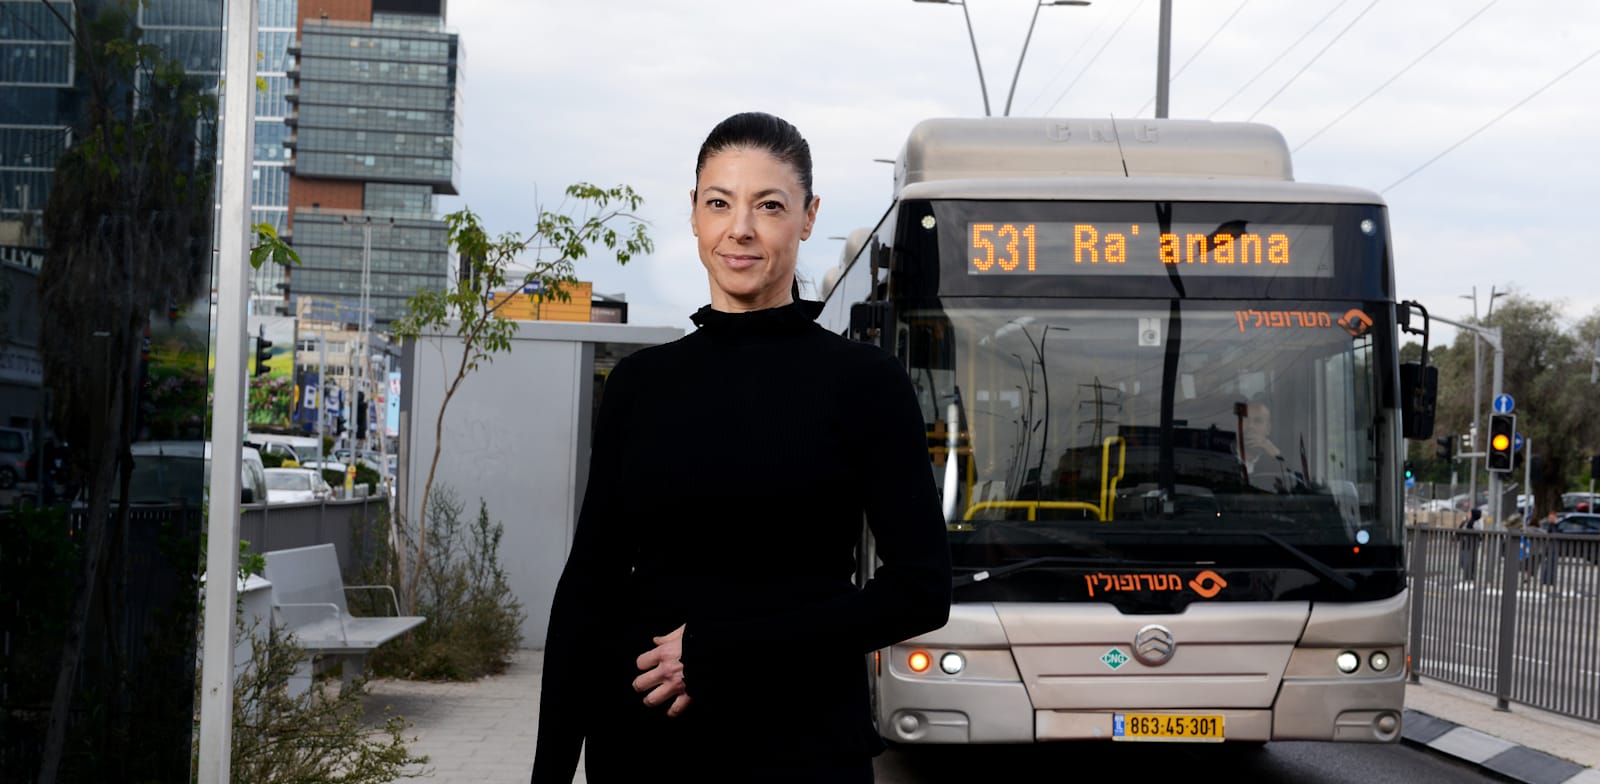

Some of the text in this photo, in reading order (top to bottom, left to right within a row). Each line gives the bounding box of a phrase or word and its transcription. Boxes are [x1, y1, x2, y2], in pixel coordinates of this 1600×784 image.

[973, 223, 1036, 271] 531
[1235, 309, 1331, 333] מטרופולין
[1085, 573, 1182, 597] מטרופולין
[1105, 654, 1124, 664] CNG
